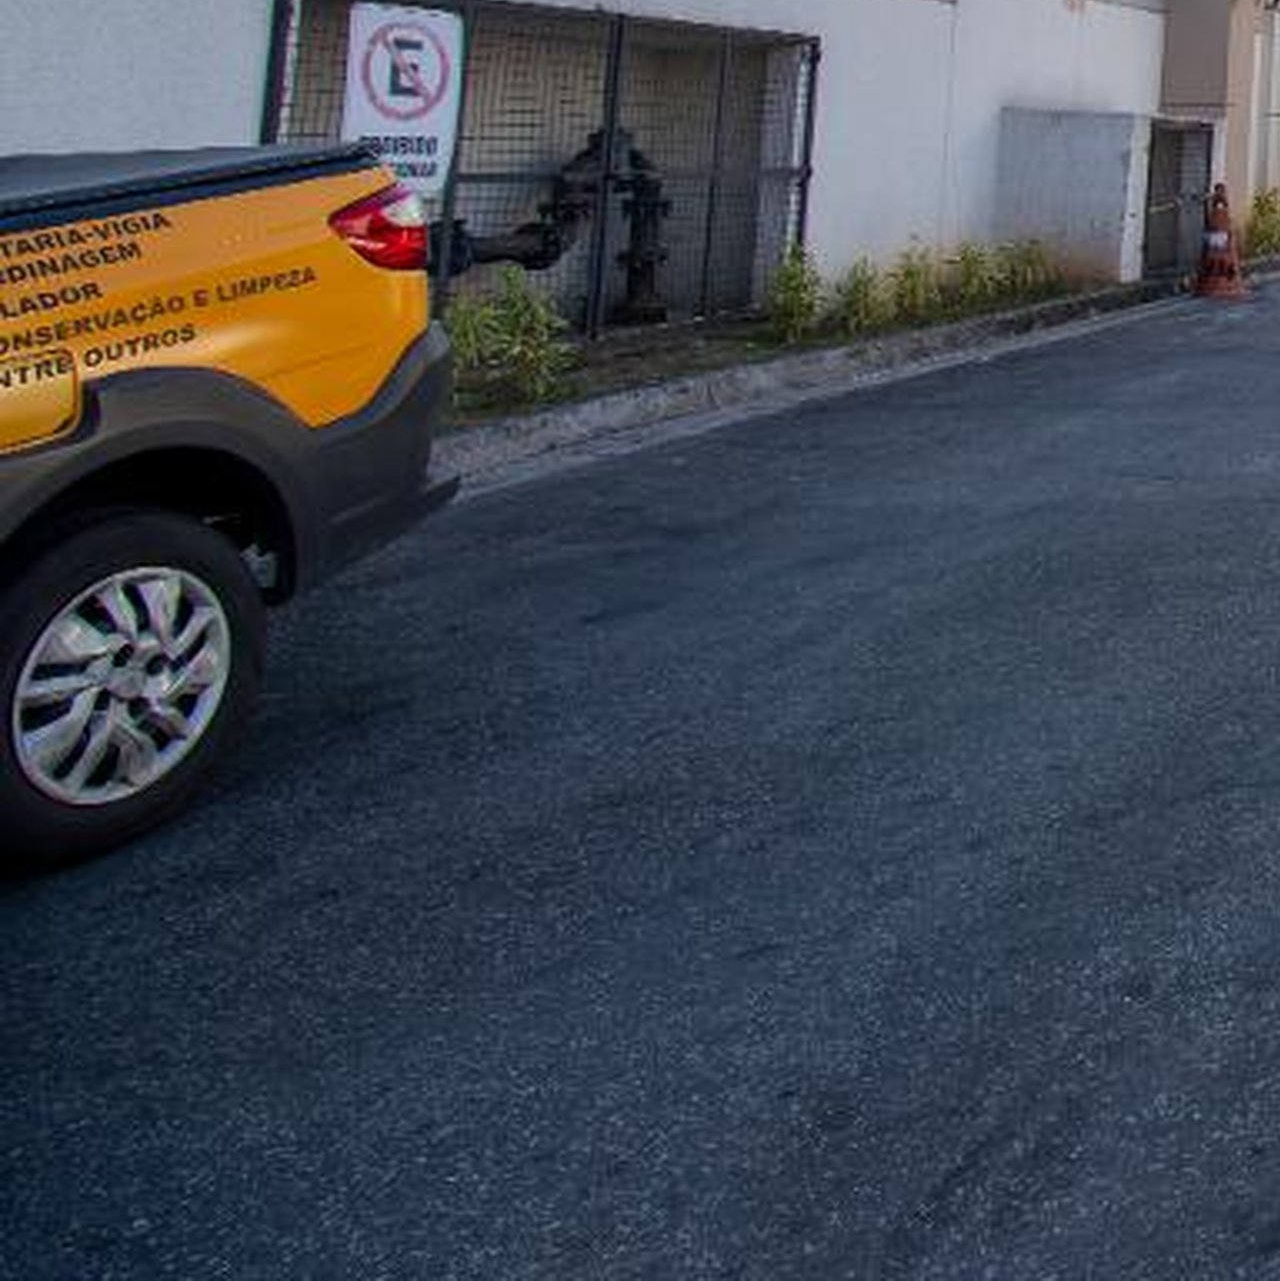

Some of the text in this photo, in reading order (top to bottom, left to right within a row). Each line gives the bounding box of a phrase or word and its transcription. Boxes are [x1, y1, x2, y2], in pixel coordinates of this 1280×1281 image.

[193, 288, 209, 308] E
[216, 266, 317, 302] LIMPEZA
[82, 322, 196, 368] OUTROS
